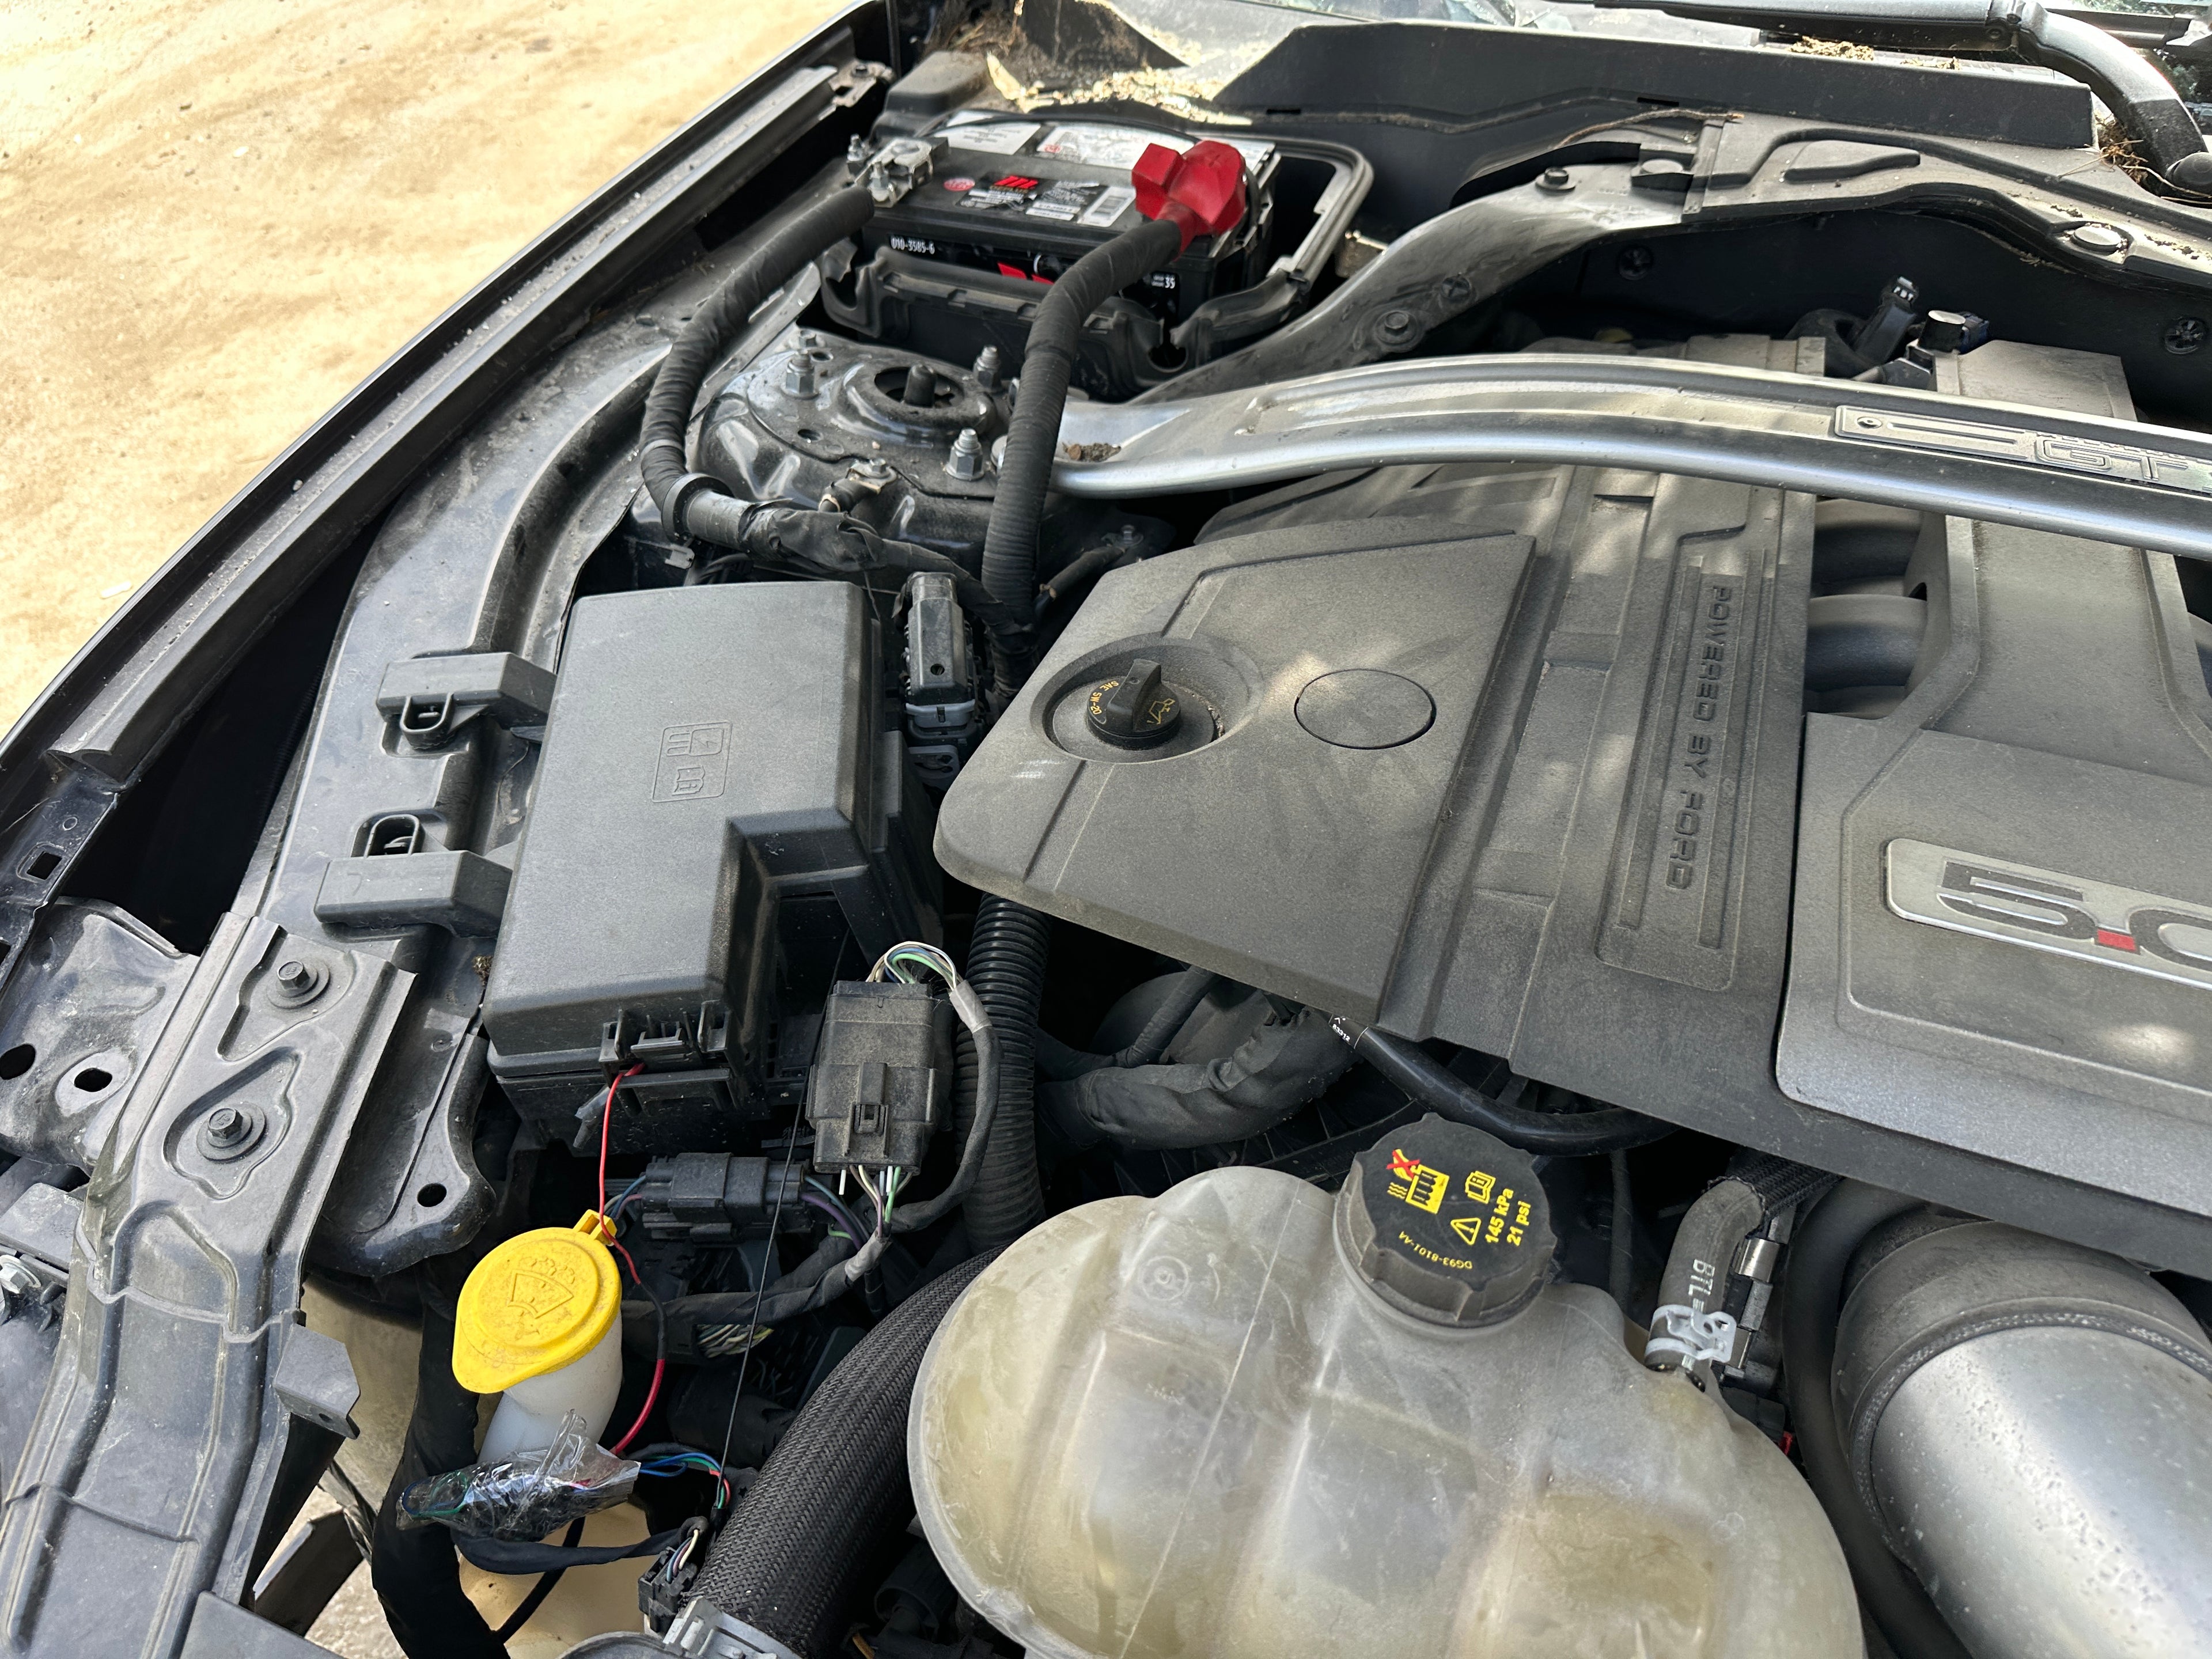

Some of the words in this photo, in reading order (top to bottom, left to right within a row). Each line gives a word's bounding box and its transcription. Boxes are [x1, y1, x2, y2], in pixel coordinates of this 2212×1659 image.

[1692, 585, 1732, 722] POWERED
[1090, 692, 1103, 715] 5W-20
[1099, 680, 1119, 691] SAE
[1684, 732, 1713, 779] BY
[1665, 788, 1704, 891] FORD
[1493, 1188, 1514, 1217] kPa
[1485, 1216, 1505, 1243] 145
[1506, 1226, 1524, 1247] 21
[1516, 1200, 1531, 1226] psi
